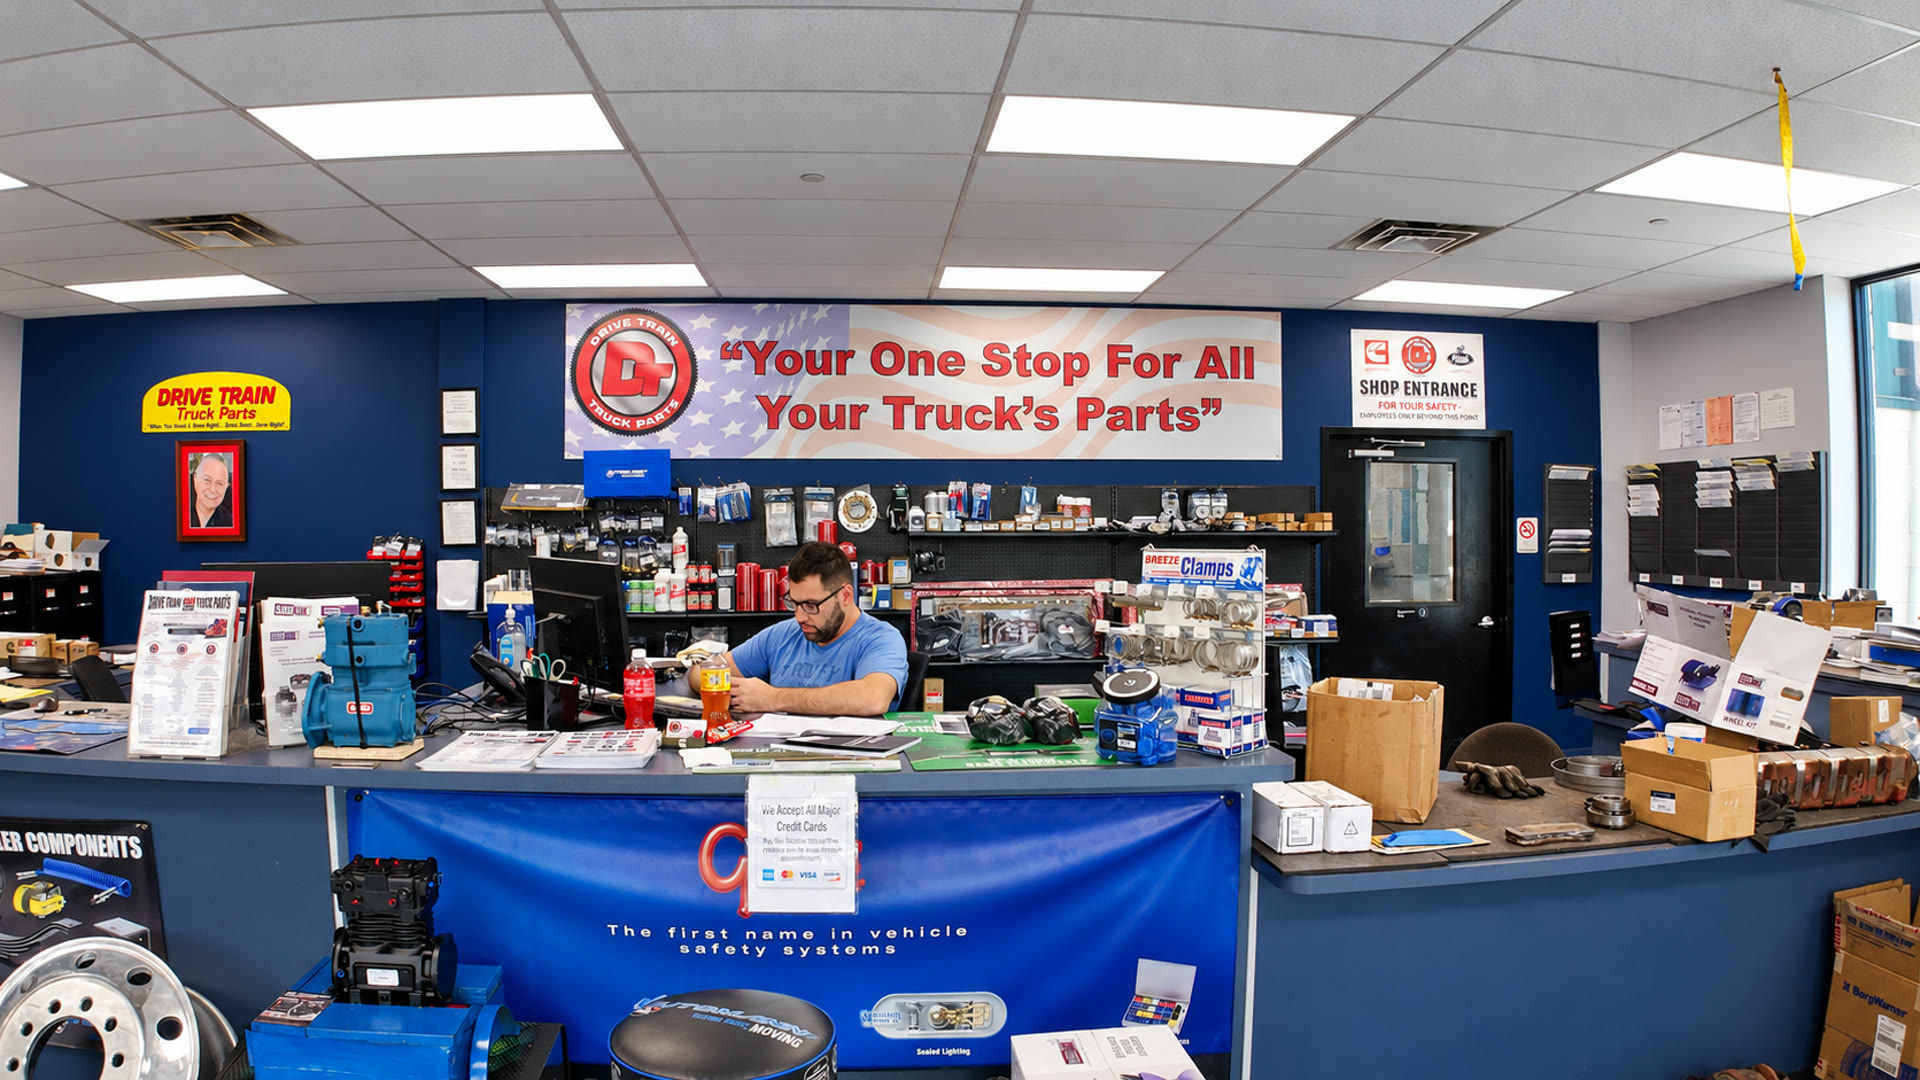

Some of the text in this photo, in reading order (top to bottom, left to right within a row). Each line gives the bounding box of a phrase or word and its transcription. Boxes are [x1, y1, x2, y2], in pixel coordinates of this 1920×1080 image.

[590, 317, 679, 347] DRIVE TRAIN
[720, 340, 1255, 387] “Your One Stop For All
[157, 386, 277, 407] DRIVE TRAIN
[1360, 379, 1478, 398] SHOP ENTRANCE
[177, 406, 257, 421] Truck Parts
[588, 398, 680, 429] TRUCK PARTS
[755, 395, 1222, 433] Your Truck’s Parts”
[1378, 401, 1396, 410] FOR
[1181, 556, 1234, 581] Clamps
[761, 804, 841, 818] We Accept All Major
[776, 820, 828, 832] Credit Cards
[24, 831, 143, 859] COMPONENTS
[799, 871, 817, 879] VISA
[607, 924, 967, 941] The first name in vehicle
[679, 943, 896, 958] safety systems
[1852, 985, 1908, 1018] BorgWarner
[749, 1023, 804, 1049] MOVING
